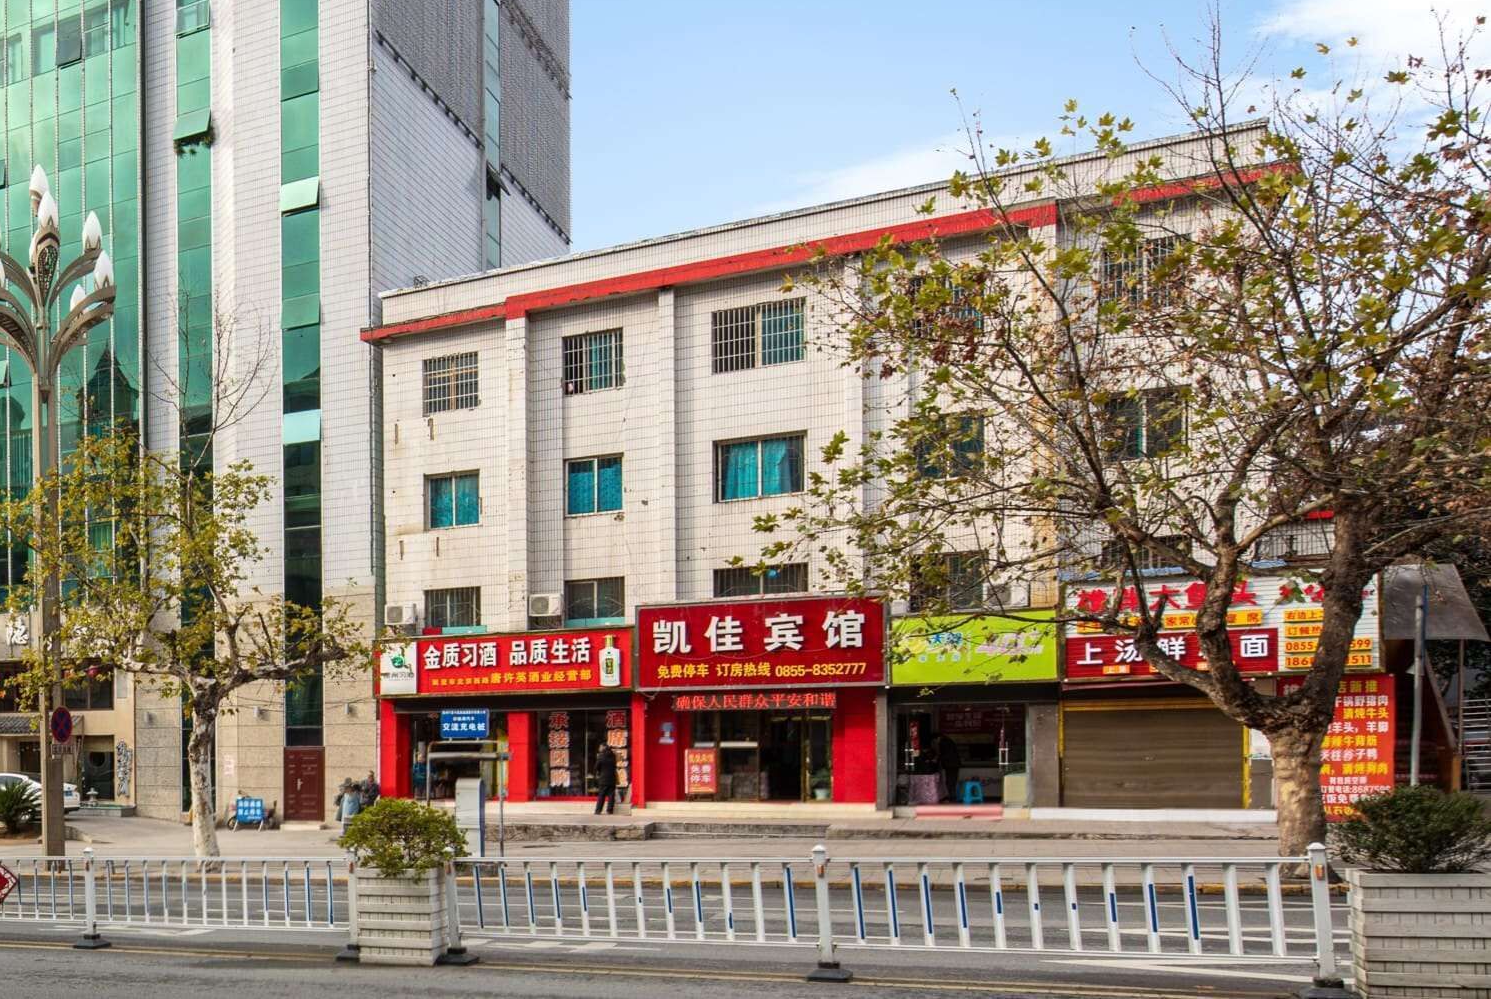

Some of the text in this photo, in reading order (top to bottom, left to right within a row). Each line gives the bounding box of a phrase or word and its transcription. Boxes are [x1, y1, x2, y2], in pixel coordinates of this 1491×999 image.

[652, 609, 866, 655] 凯佳宾馆
[423, 637, 591, 670] 金质习酒 品质生活
[1076, 634, 1270, 665] 上汤鲜面
[657, 661, 867, 680] 免费停车 订房热线 0855-8352777
[675, 691, 837, 711] 确保人民群众平安和谐
[442, 722, 486, 731] 交流充电桩
